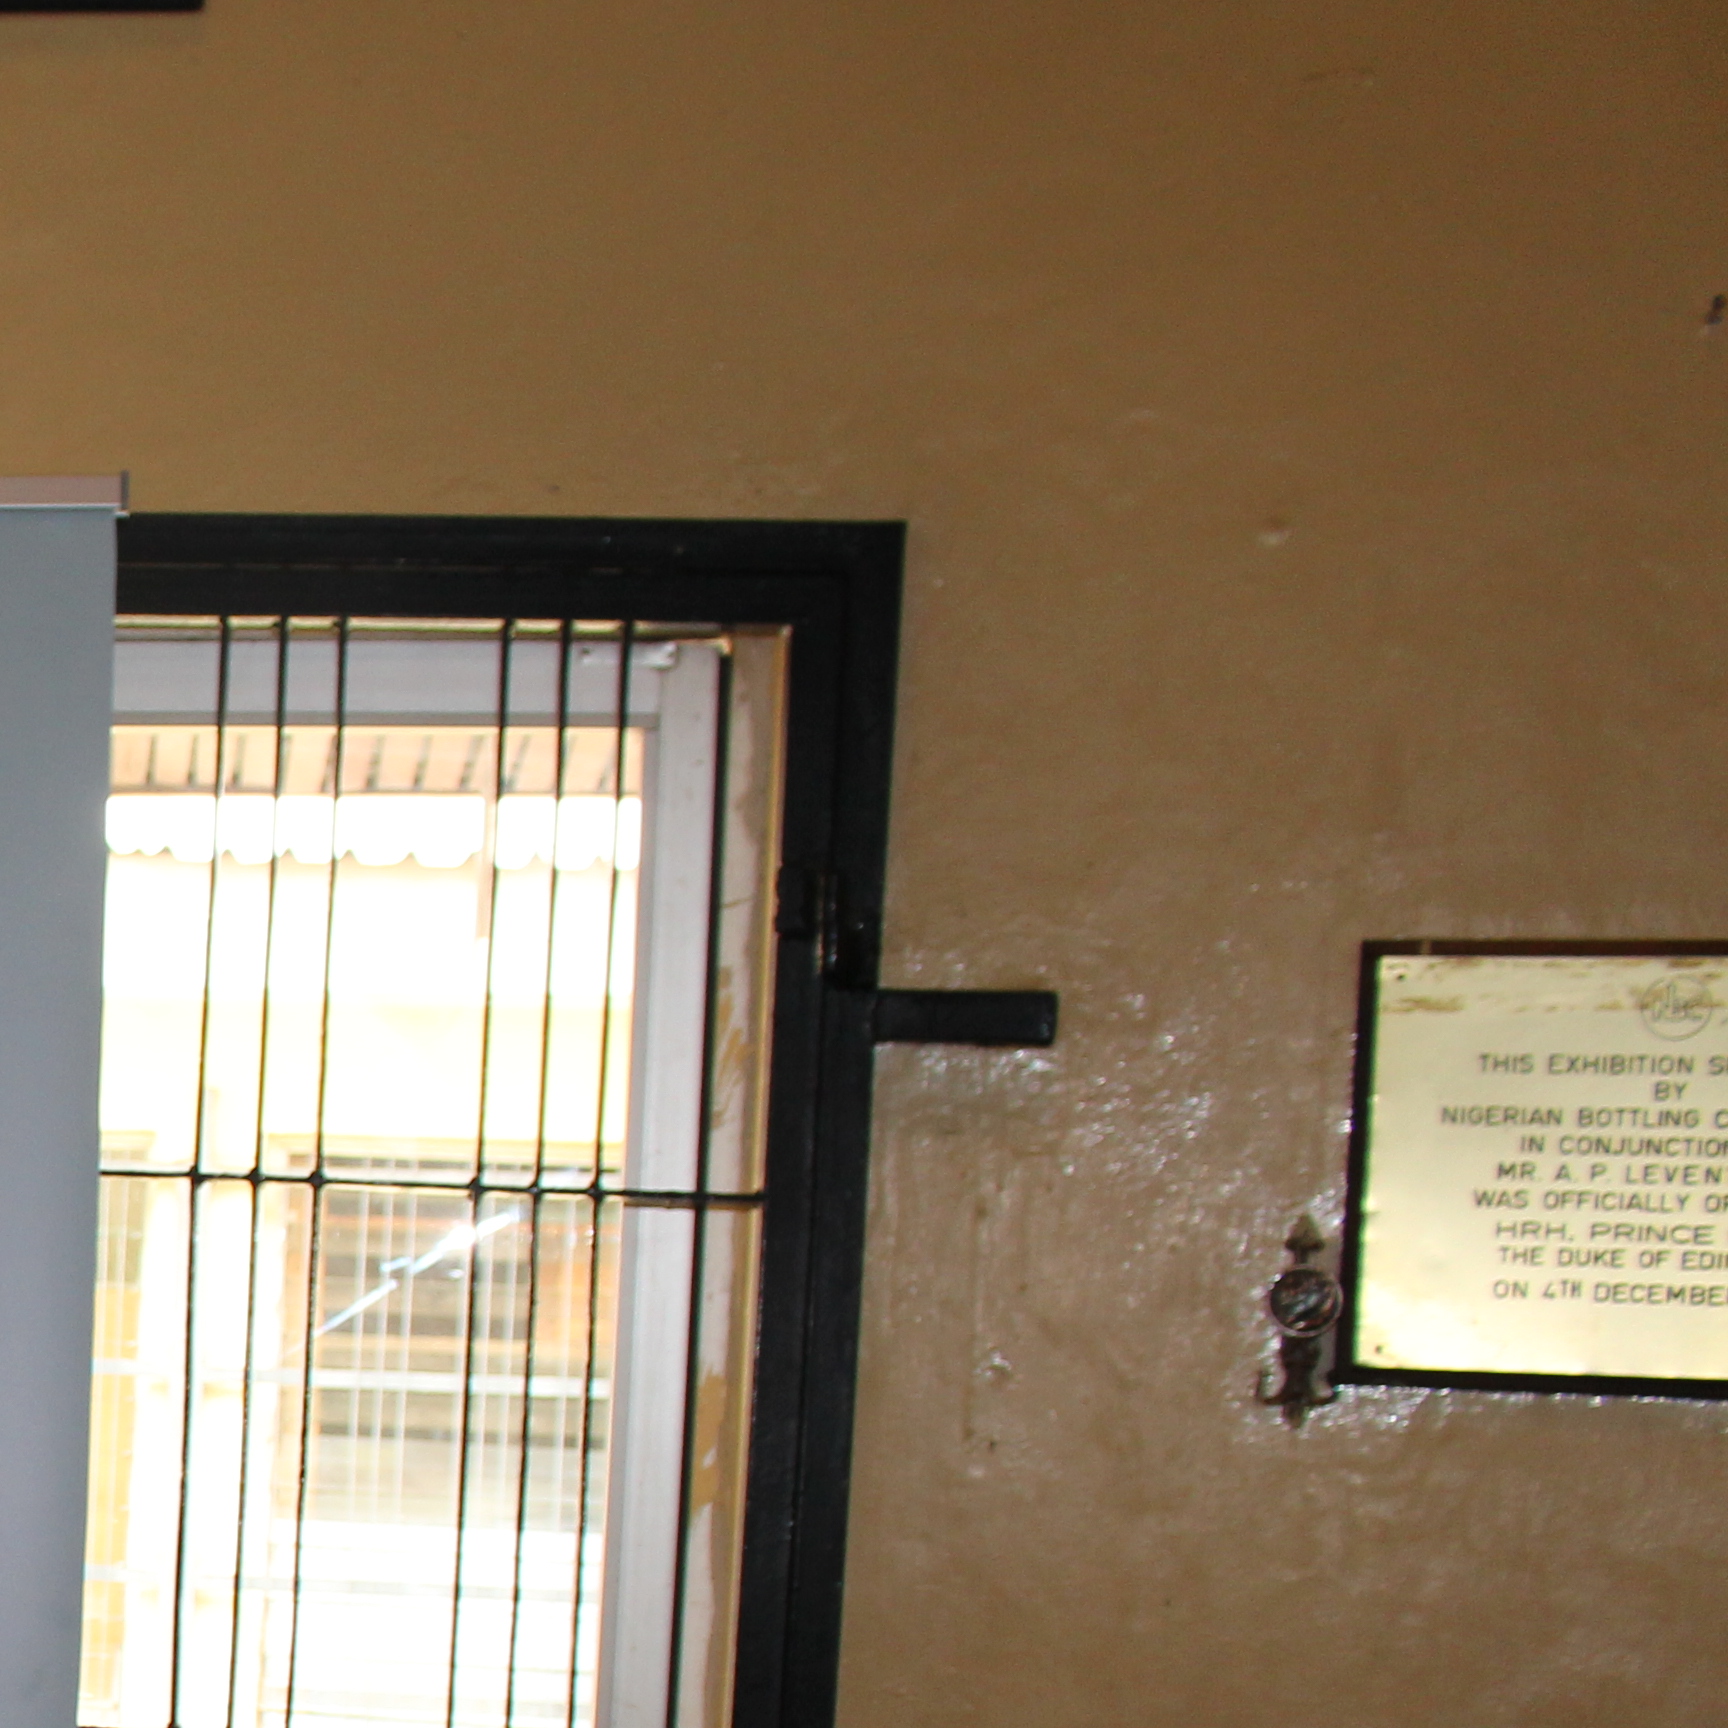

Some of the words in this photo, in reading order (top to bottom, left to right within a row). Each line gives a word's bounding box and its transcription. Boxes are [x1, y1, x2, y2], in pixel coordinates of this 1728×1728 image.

[1478, 1053, 1536, 1075] THIS
[1548, 1053, 1696, 1076] EXHIBITION
[1707, 1054, 1728, 1077] S
[1653, 1080, 1688, 1102] BY
[1440, 1106, 1564, 1127] NIGERIAN
[1577, 1107, 1702, 1129] BOTTLING
[1520, 1135, 1546, 1154] IN
[1625, 1163, 1728, 1185] LEVEN
[1473, 1189, 1530, 1210] WAS
[1542, 1190, 1691, 1212] OFFICIALLY
[1589, 1221, 1716, 1245] PRINCE
[1499, 1245, 1547, 1267] THE
[1556, 1247, 1628, 1268] DUKE
[1638, 1249, 1672, 1269] OF
[1681, 1250, 1728, 1271] EDI
[1492, 1279, 1529, 1299] ON
[1593, 1282, 1728, 1307] DECEMBE
